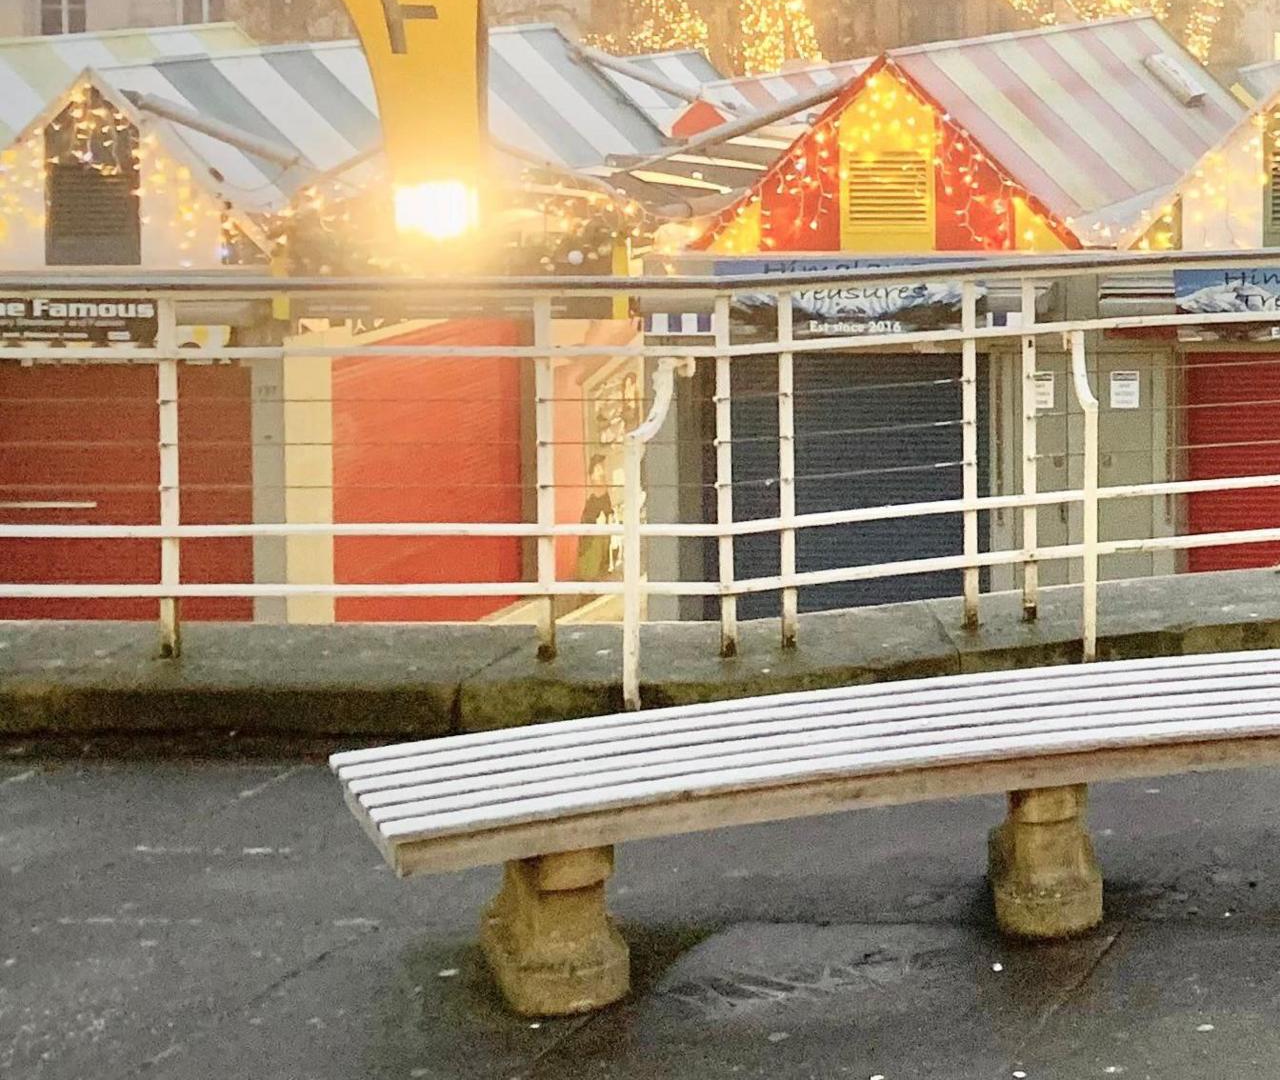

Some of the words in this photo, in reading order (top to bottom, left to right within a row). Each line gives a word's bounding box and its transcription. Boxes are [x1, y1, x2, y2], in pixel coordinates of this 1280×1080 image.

[799, 283, 929, 302] reasures
[33, 298, 155, 318] Famous
[809, 320, 829, 333] Est
[832, 321, 864, 333] since
[868, 320, 902, 332] 2016
